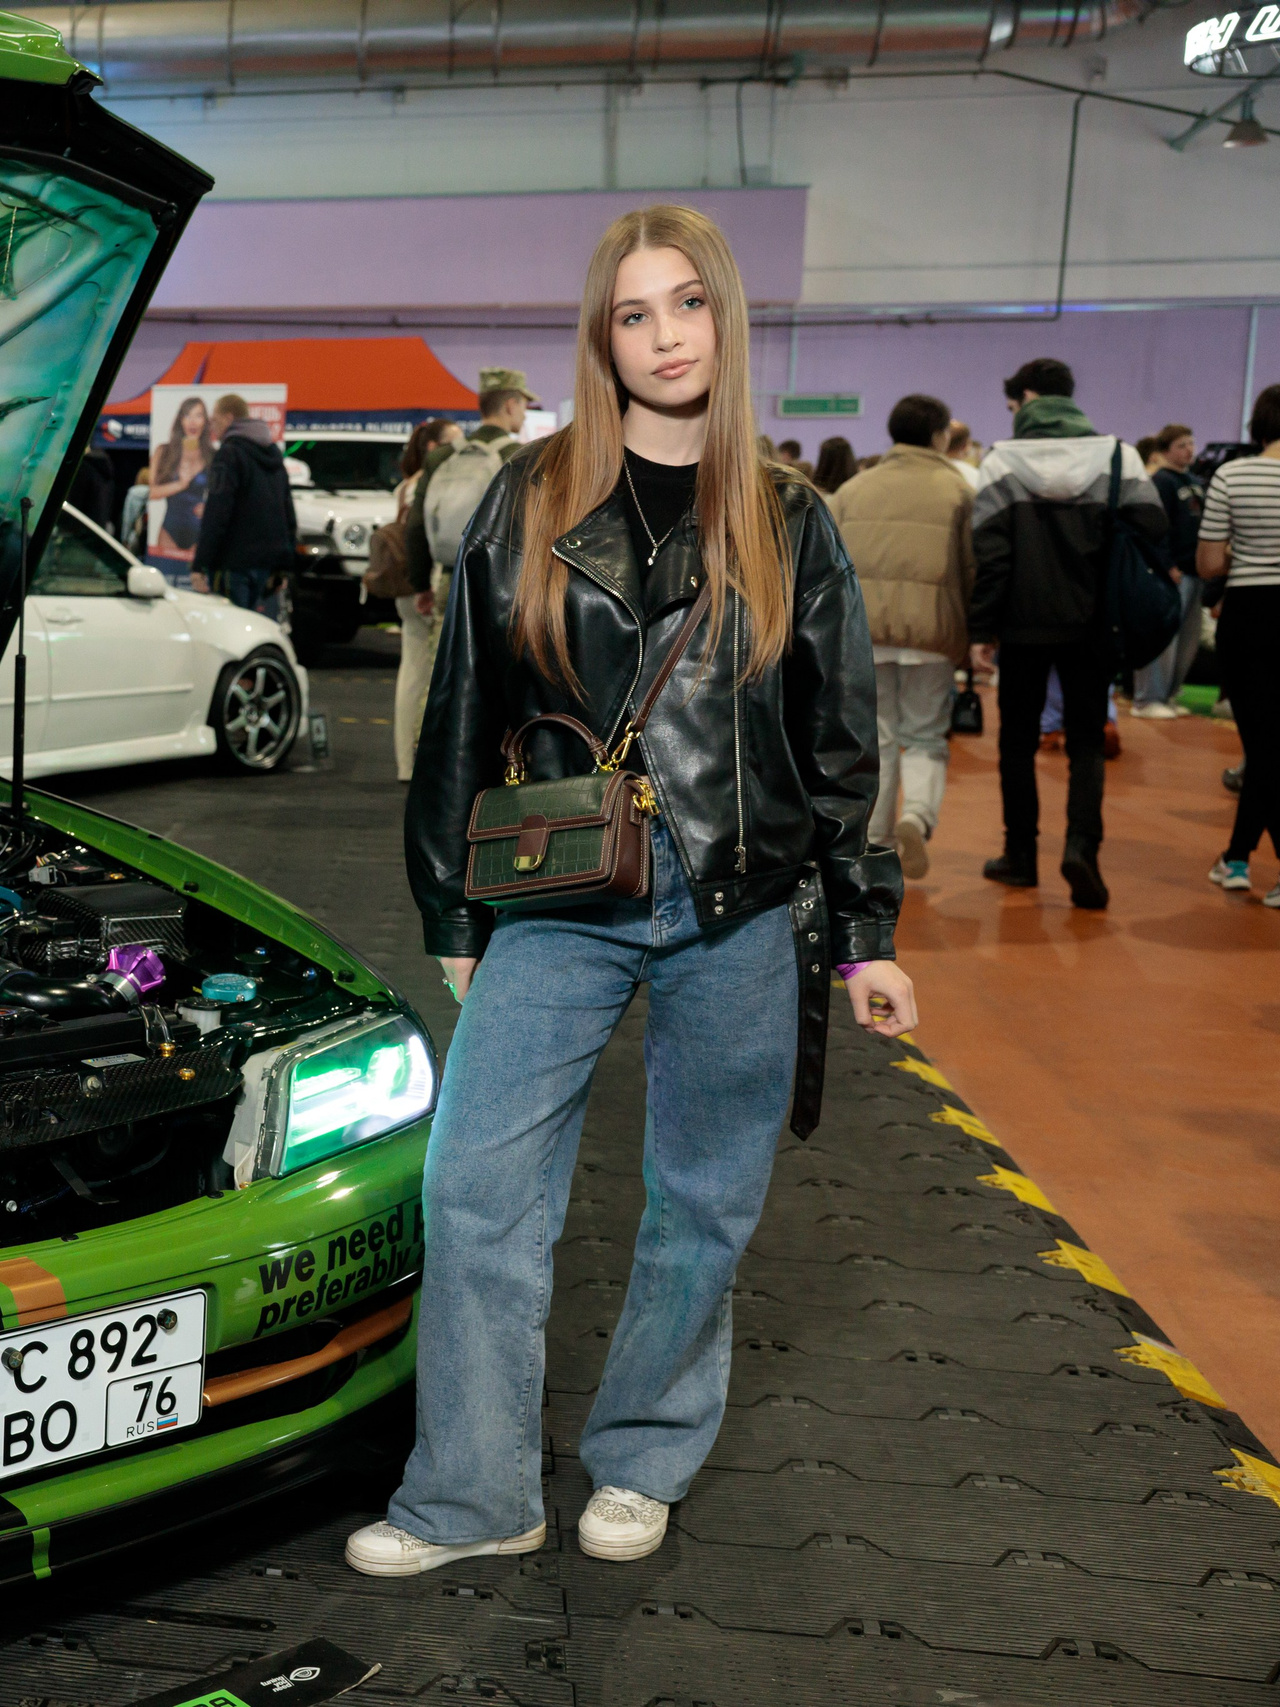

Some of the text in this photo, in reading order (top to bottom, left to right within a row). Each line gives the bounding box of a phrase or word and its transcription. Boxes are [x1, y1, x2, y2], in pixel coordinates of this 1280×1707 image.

[258, 1249, 316, 1295] we
[327, 1204, 404, 1272] need
[252, 1245, 410, 1340] preferably
[67, 1314, 158, 1381] 892
[126, 1421, 155, 1438] RUS
[133, 1376, 177, 1423] 76
